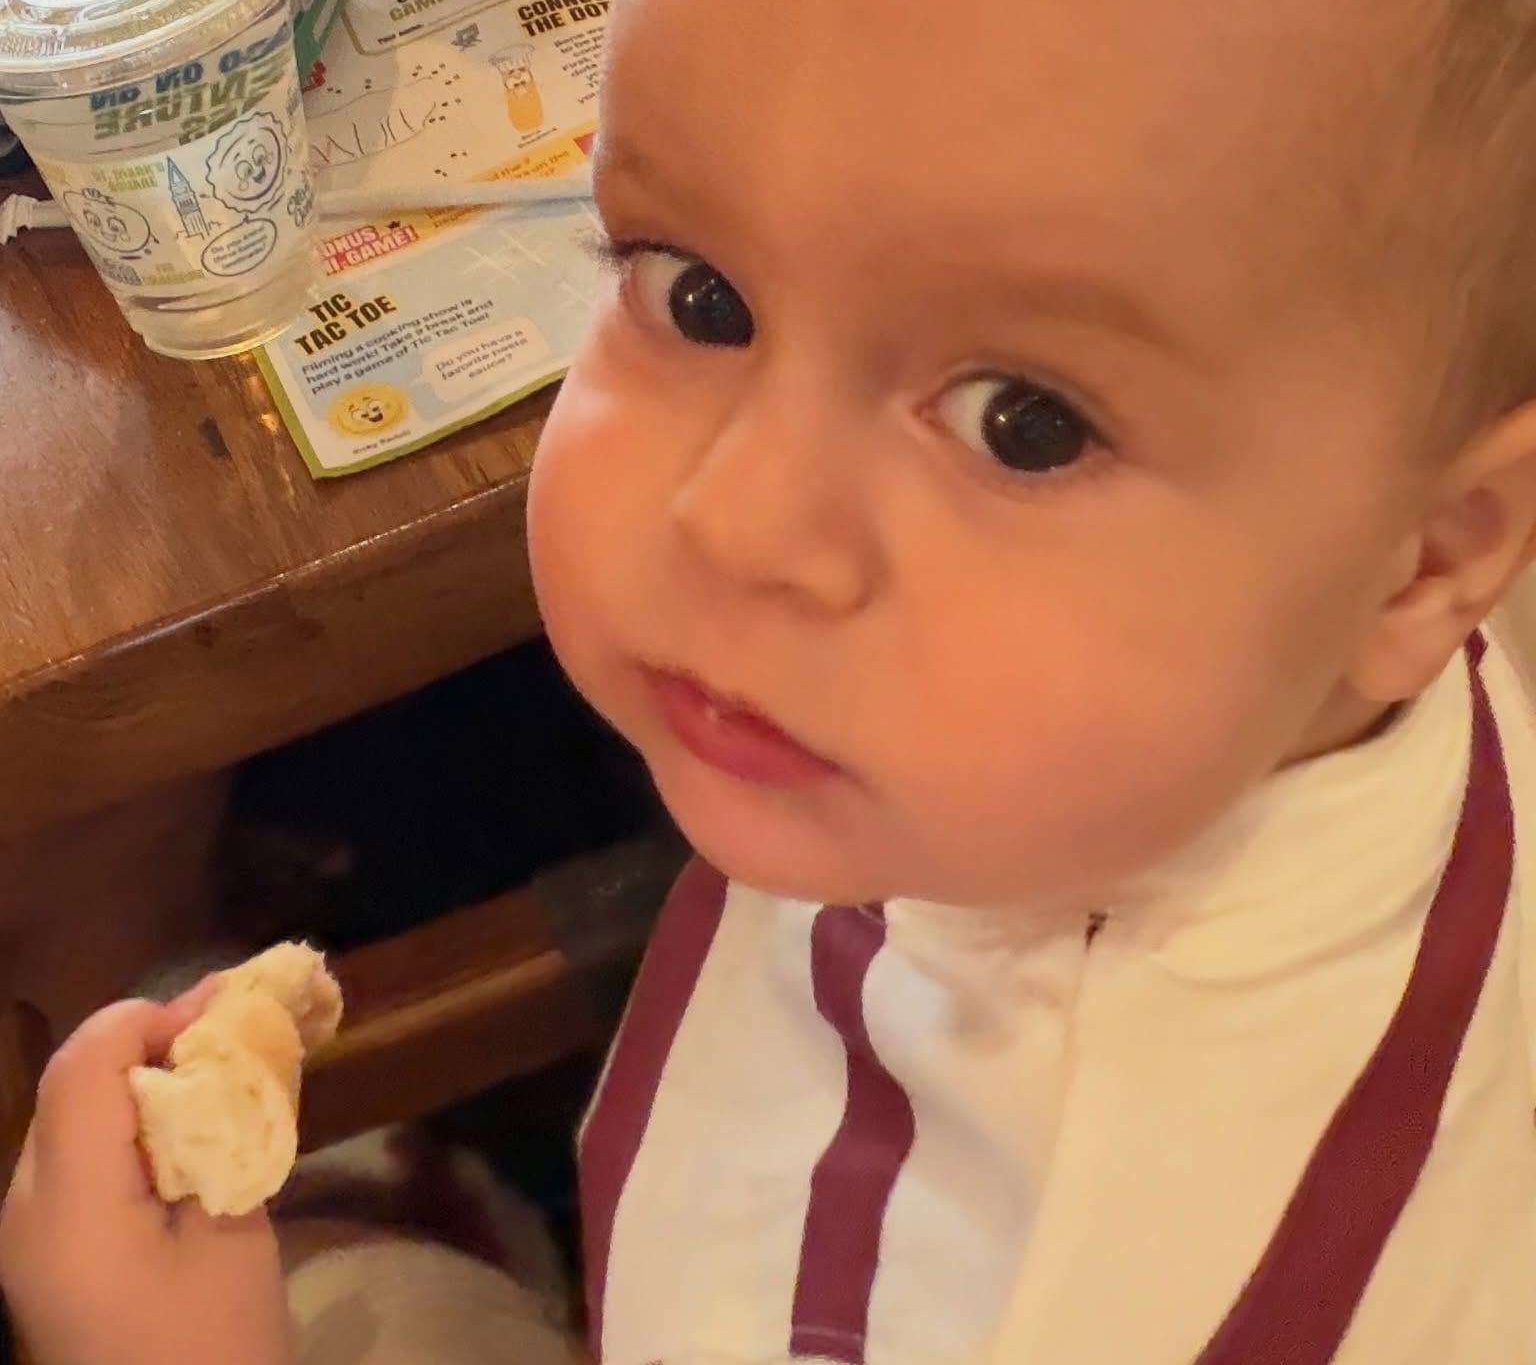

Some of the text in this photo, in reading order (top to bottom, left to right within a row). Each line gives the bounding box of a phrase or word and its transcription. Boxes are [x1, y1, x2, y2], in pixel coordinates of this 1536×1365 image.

[521, 12, 568, 38] THE
[321, 224, 379, 257] ONUS
[294, 295, 397, 356] TAC TOE
[308, 292, 353, 324] TIC
[302, 349, 353, 374] Filming
[366, 320, 421, 346] cooking
[422, 303, 458, 322] show
[460, 296, 472, 308] is
[307, 366, 338, 384] hard
[340, 349, 379, 369] work!
[382, 333, 413, 351] Take
[426, 311, 464, 332] break
[466, 299, 493, 316] and
[312, 377, 341, 394] play
[355, 355, 395, 376] game
[395, 346, 408, 358] of
[411, 334, 432, 350] Tic
[436, 323, 458, 339] Tac
[462, 312, 489, 327] Toe!
[436, 358, 454, 372] Do
[456, 347, 480, 363] you
[481, 333, 512, 350] have
[441, 338, 528, 378] favorite pasta
[468, 355, 513, 377] sauce?
